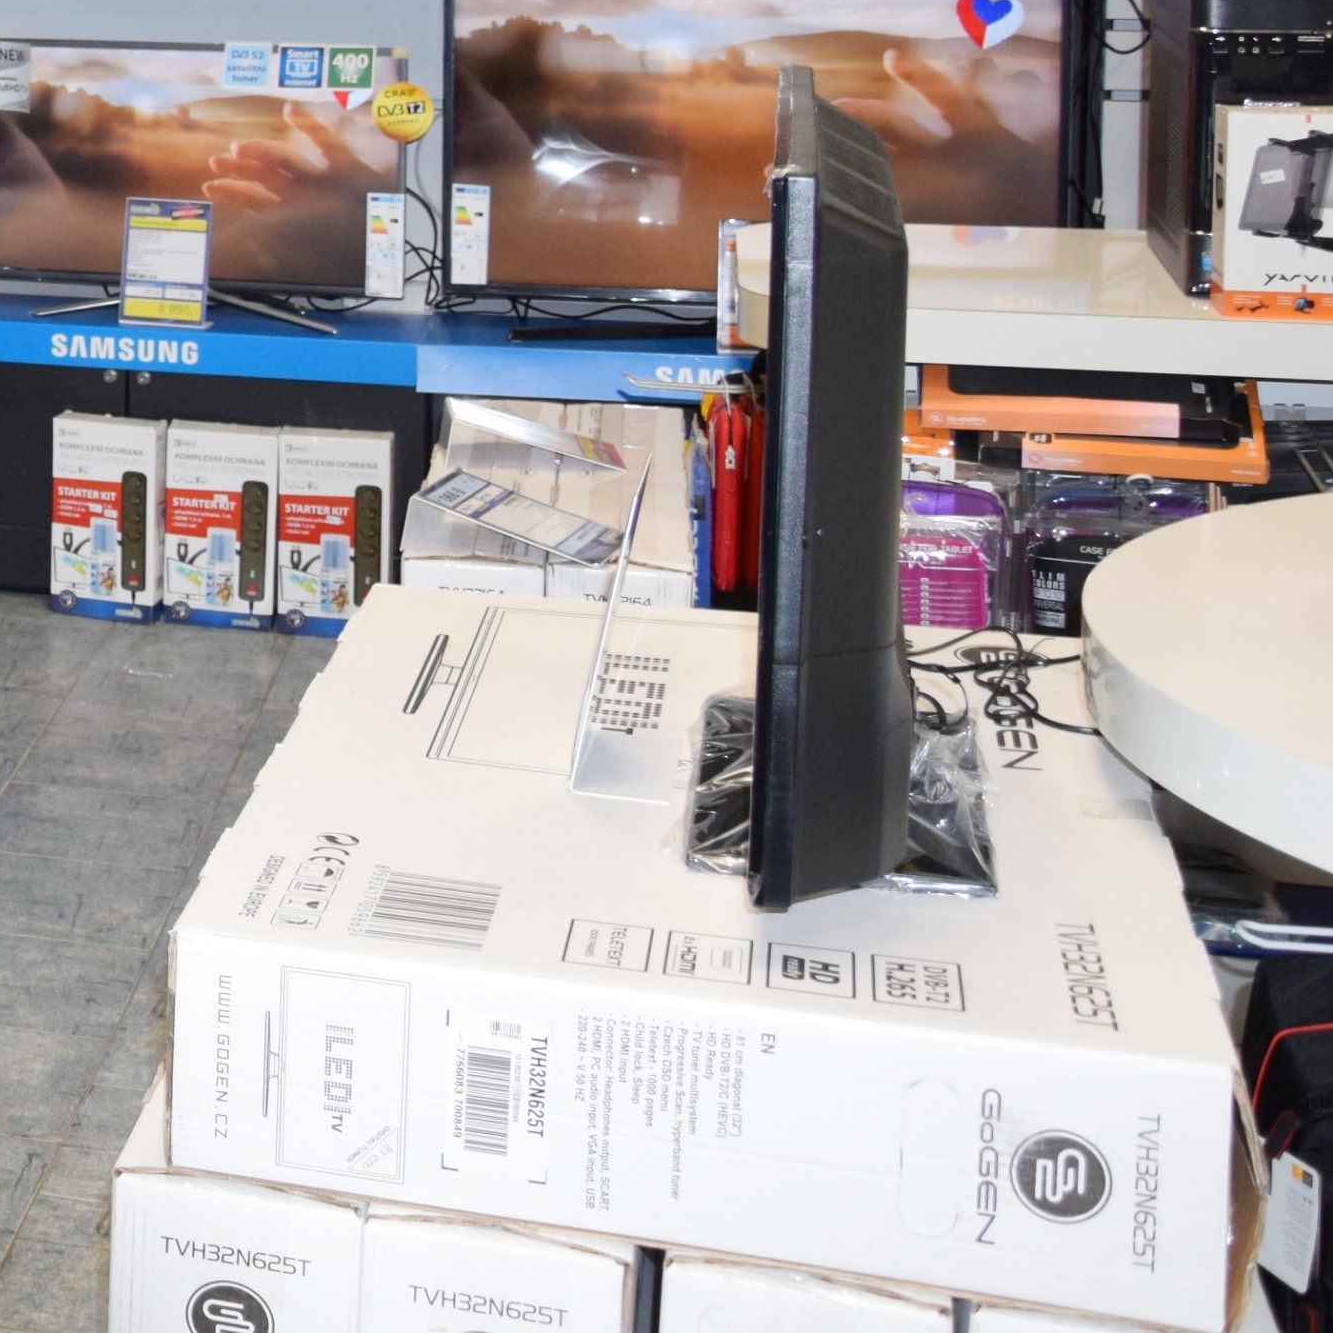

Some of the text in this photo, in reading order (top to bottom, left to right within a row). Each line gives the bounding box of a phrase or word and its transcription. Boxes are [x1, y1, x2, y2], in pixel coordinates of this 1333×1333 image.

[0, 48, 26, 62] NEW
[287, 49, 319, 60] Smart
[293, 63, 309, 73] TV
[333, 53, 369, 69] 400
[232, 74, 258, 83] tuner
[341, 73, 359, 84] Hz
[408, 102, 425, 114] T2
[51, 333, 199, 365] SAMSUNG
[104, 445, 144, 457] OCHRANA
[227, 456, 266, 467] OCHRANA
[334, 460, 378, 470] OCHRANA
[57, 486, 117, 502] STARTER KIT
[284, 502, 349, 517] STARTER KIT
[939, 545, 973, 555] TABLET
[1080, 545, 1104, 555] CASE
[238, 855, 285, 918] DESIGNED EUROPE
[606, 926, 628, 967] TELETEXT
[809, 959, 840, 985] HD
[884, 961, 917, 1001] H.265
[922, 965, 950, 1004] DVB-T2
[1055, 922, 1120, 1033] TVH32N625T
[620, 1031, 630, 1056] HDMI
[648, 1023, 660, 1064] Teletext
[761, 1032, 776, 1055] EN
[704, 1049, 716, 1082] Ready
[526, 1036, 548, 1139] TVH32N625T
[630, 1076, 642, 1105] Sleep
[660, 1084, 669, 1113] menu
[672, 1027, 688, 1173] Progressive hyperband
[734, 1069, 745, 1112] diagonal
[601, 1075, 614, 1137] Headphones
[688, 1075, 700, 1135] multisystem
[1132, 1112, 1162, 1273] TVH32N625T
[160, 1234, 312, 1278] TVH32N625T
[408, 1283, 570, 1328] TVH32N625T
